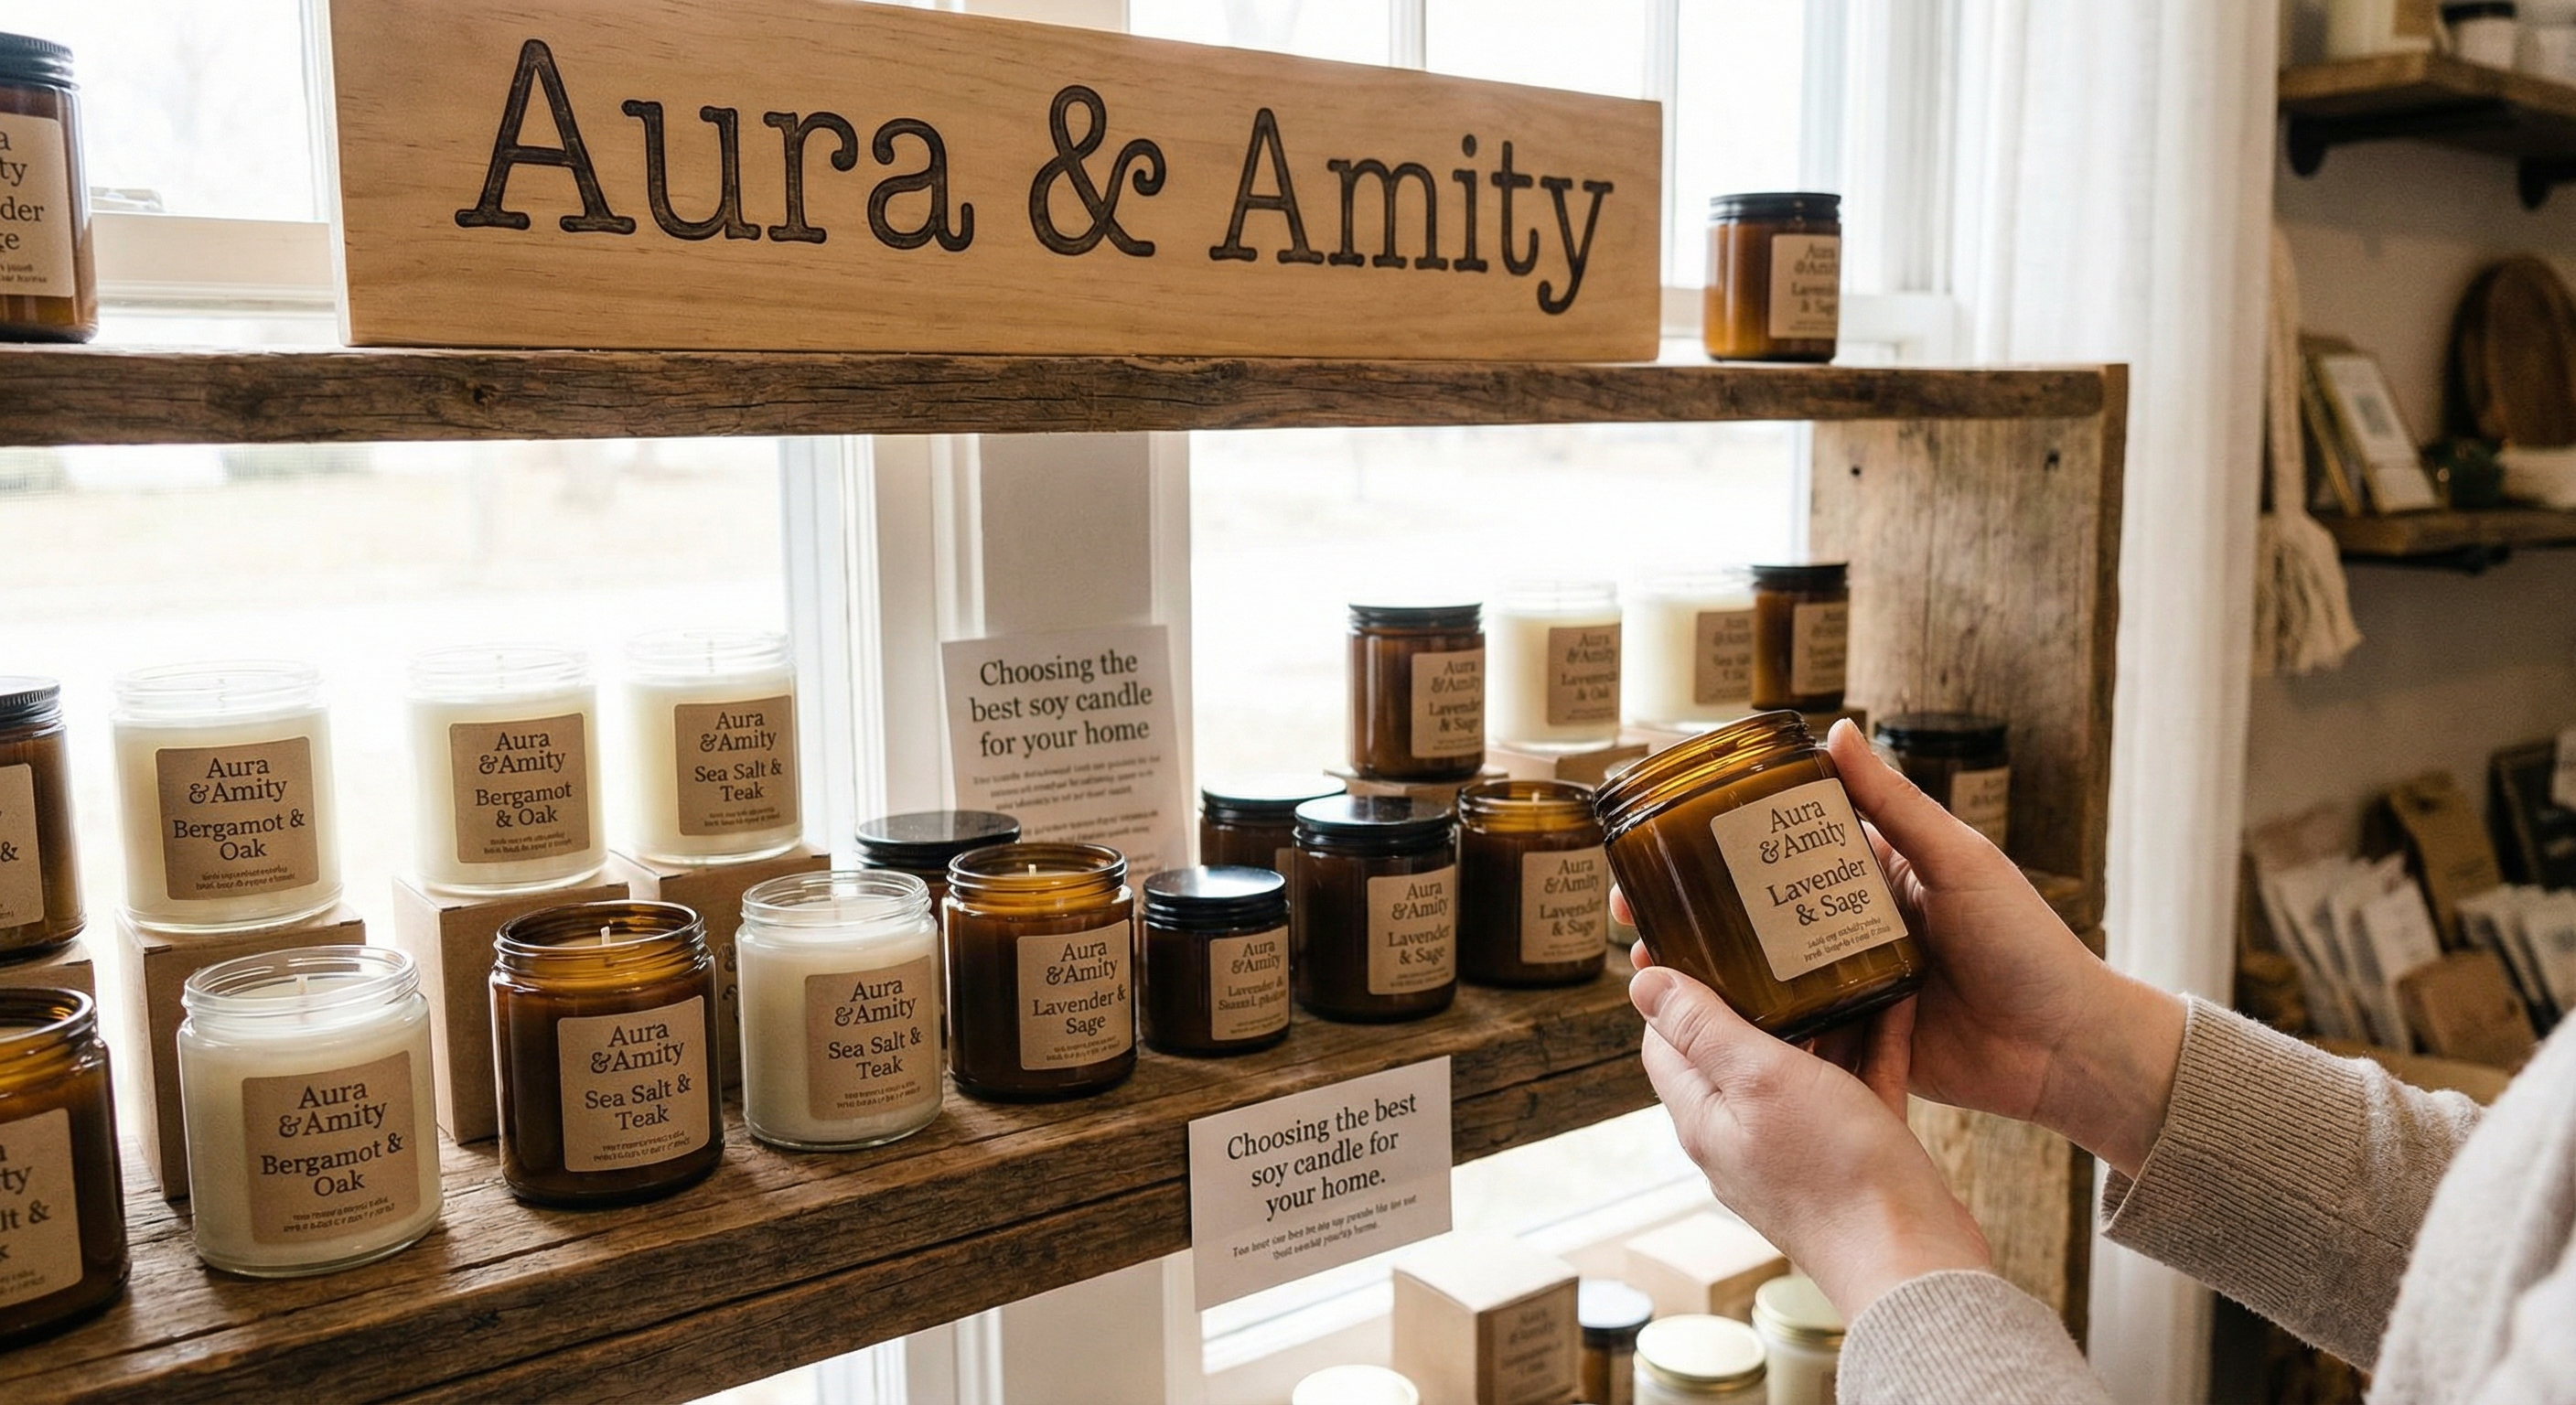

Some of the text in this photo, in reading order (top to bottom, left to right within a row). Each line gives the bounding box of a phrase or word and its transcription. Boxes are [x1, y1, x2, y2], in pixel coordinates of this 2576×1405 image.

[454, 38, 1615, 316] Aura & Amity
[980, 649, 1138, 687] Choosing the
[1444, 660, 1476, 675] Aura
[969, 681, 1154, 724] best soy candle
[715, 712, 765, 730] Aura
[494, 732, 551, 753] Aura
[980, 719, 1150, 758] for your home
[206, 757, 270, 779] Aura
[694, 757, 783, 782] Sea Salt &
[475, 781, 572, 810] Bergamot
[719, 782, 765, 803] Teak
[173, 809, 305, 841] Bergamot &
[496, 805, 558, 828] & Oak
[1771, 800, 1826, 833] Aura
[0, 842, 19, 863] &
[219, 838, 267, 861] Oak
[1558, 859, 1594, 875] Aura
[1406, 882, 1443, 901] Aura
[1766, 858, 1867, 907] Lavender
[1796, 889, 1871, 926] & Sage
[1388, 923, 1451, 948] Lavender
[1552, 921, 1564, 937] &
[1060, 941, 1107, 962] Aura
[1242, 941, 1275, 958] Aura
[1399, 946, 1445, 966] & Sage
[850, 977, 904, 1003] Aura
[1032, 983, 1126, 1016] Lavender &
[607, 1022, 670, 1047] Aura
[1066, 1015, 1107, 1036] Sage
[828, 1025, 922, 1060] Sea Salt &
[855, 1055, 904, 1080] Teak
[297, 1081, 368, 1110] Aura
[585, 1073, 692, 1110] Sea Salt &
[615, 1104, 671, 1131] Teak
[1228, 1094, 1417, 1160] Choosing the best
[261, 1133, 404, 1176] Bergamot &
[1251, 1132, 1399, 1187] soy candle for
[313, 1169, 365, 1198] Oak
[1266, 1170, 1386, 1221] your home.
[28, 1199, 51, 1225] &
